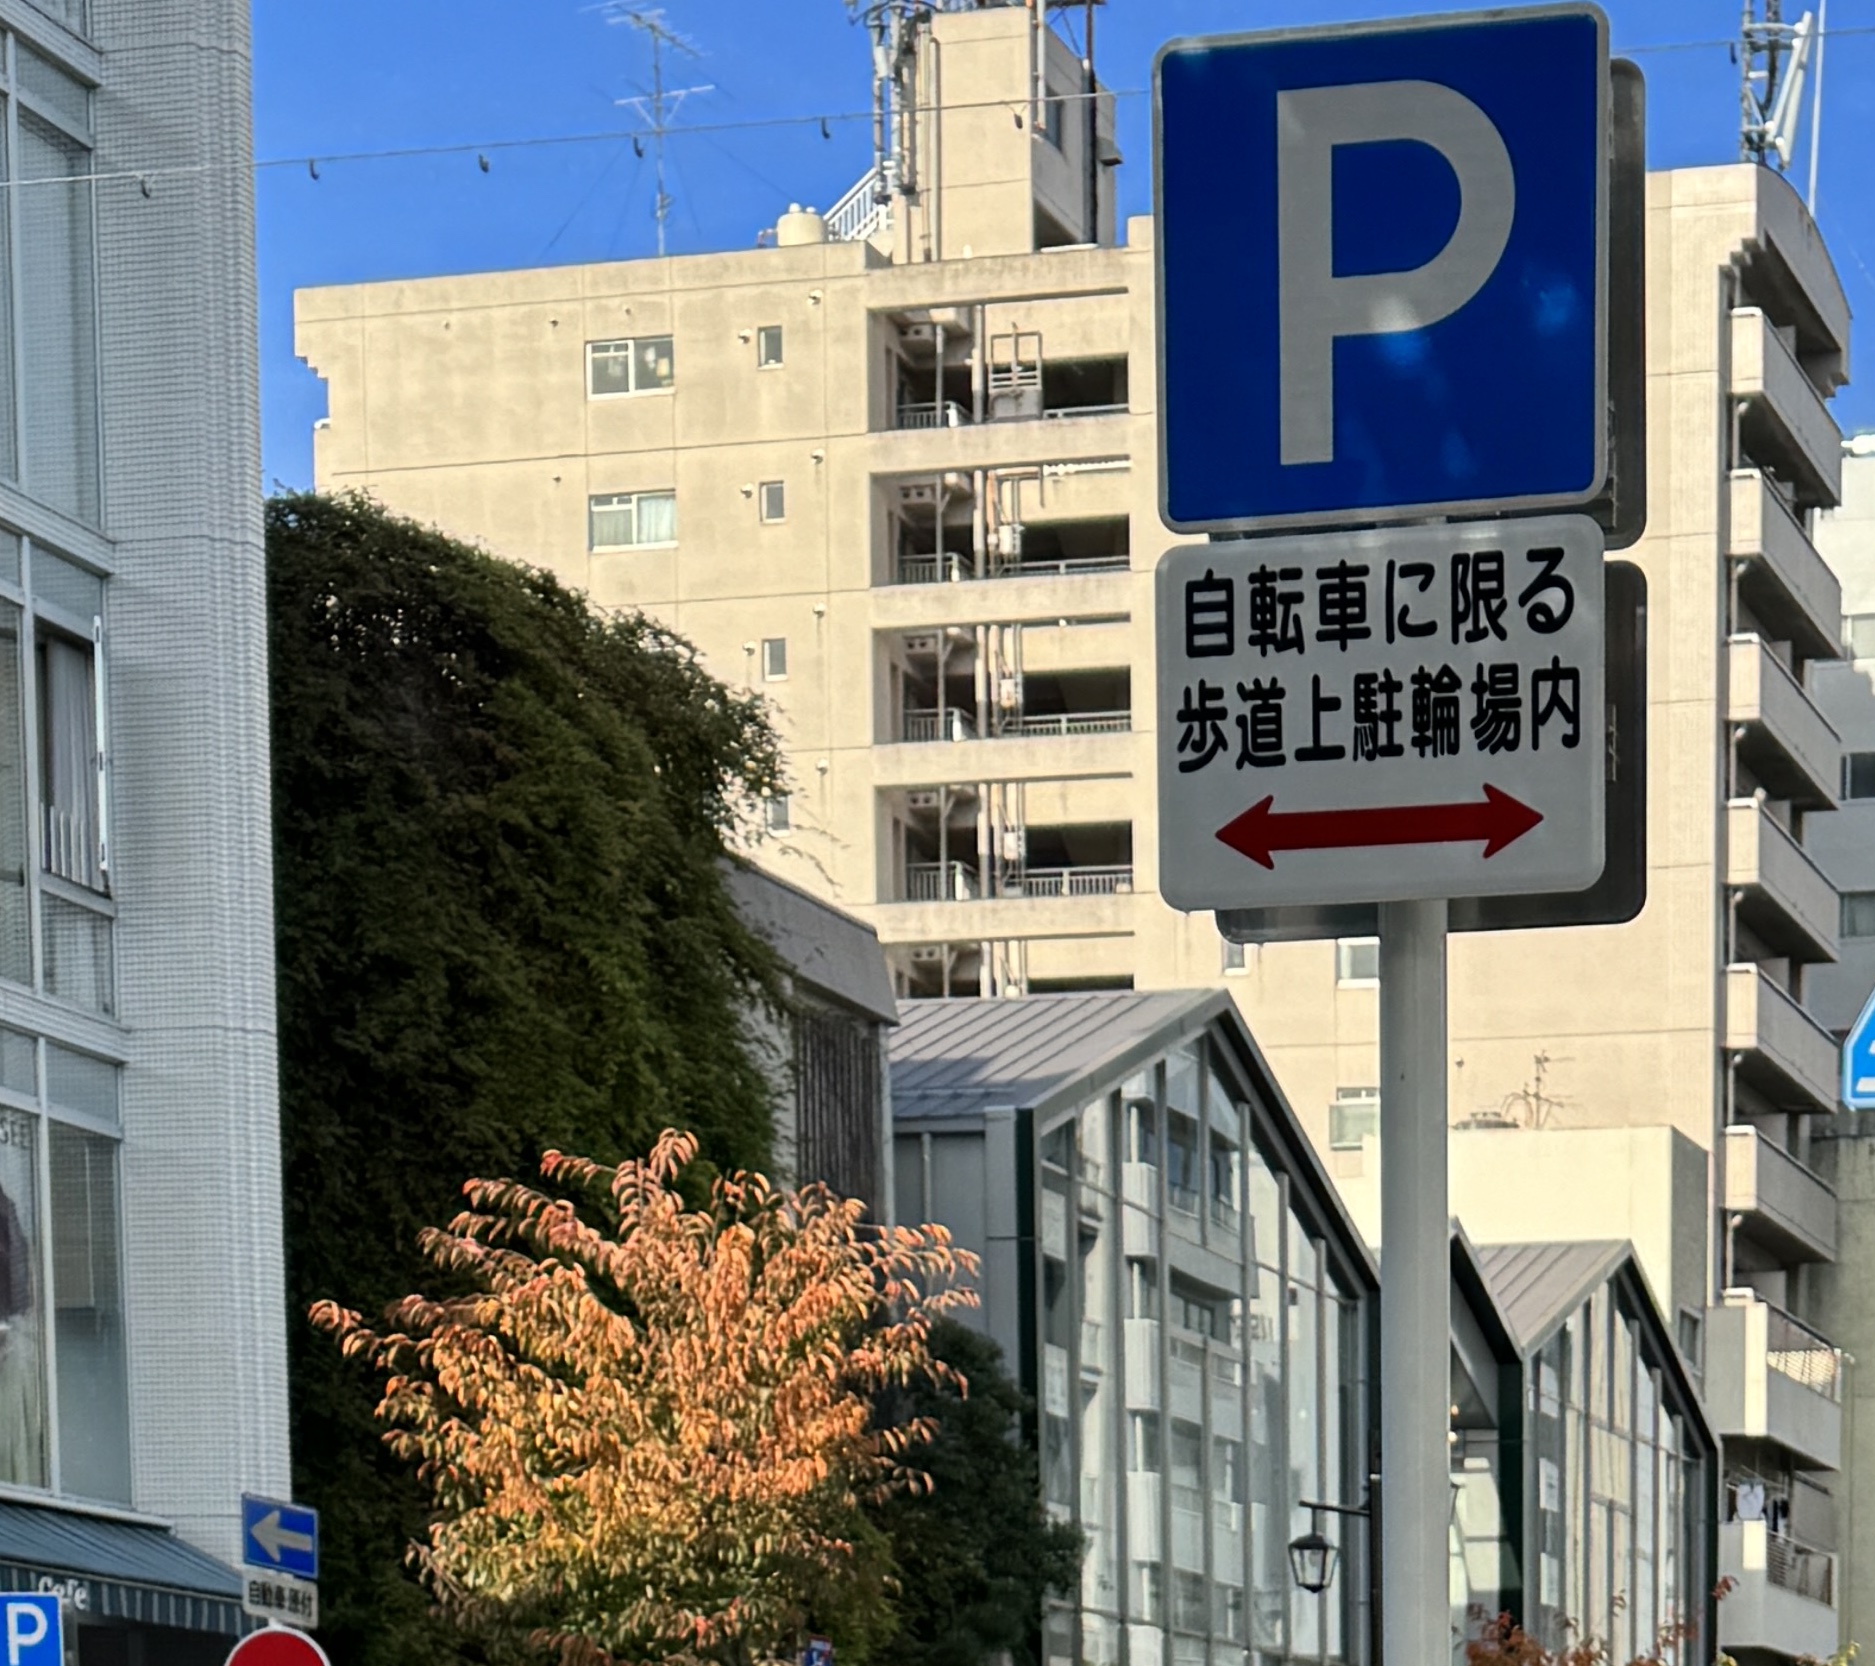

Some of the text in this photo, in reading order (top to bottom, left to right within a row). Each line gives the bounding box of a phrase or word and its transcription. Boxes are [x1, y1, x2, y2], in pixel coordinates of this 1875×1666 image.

[1277, 79, 1516, 467] P
[1184, 547, 1576, 660] 自転車に限る
[1176, 656, 1582, 774] 歩道上駐輪場内
[7, 1602, 47, 1666] P
